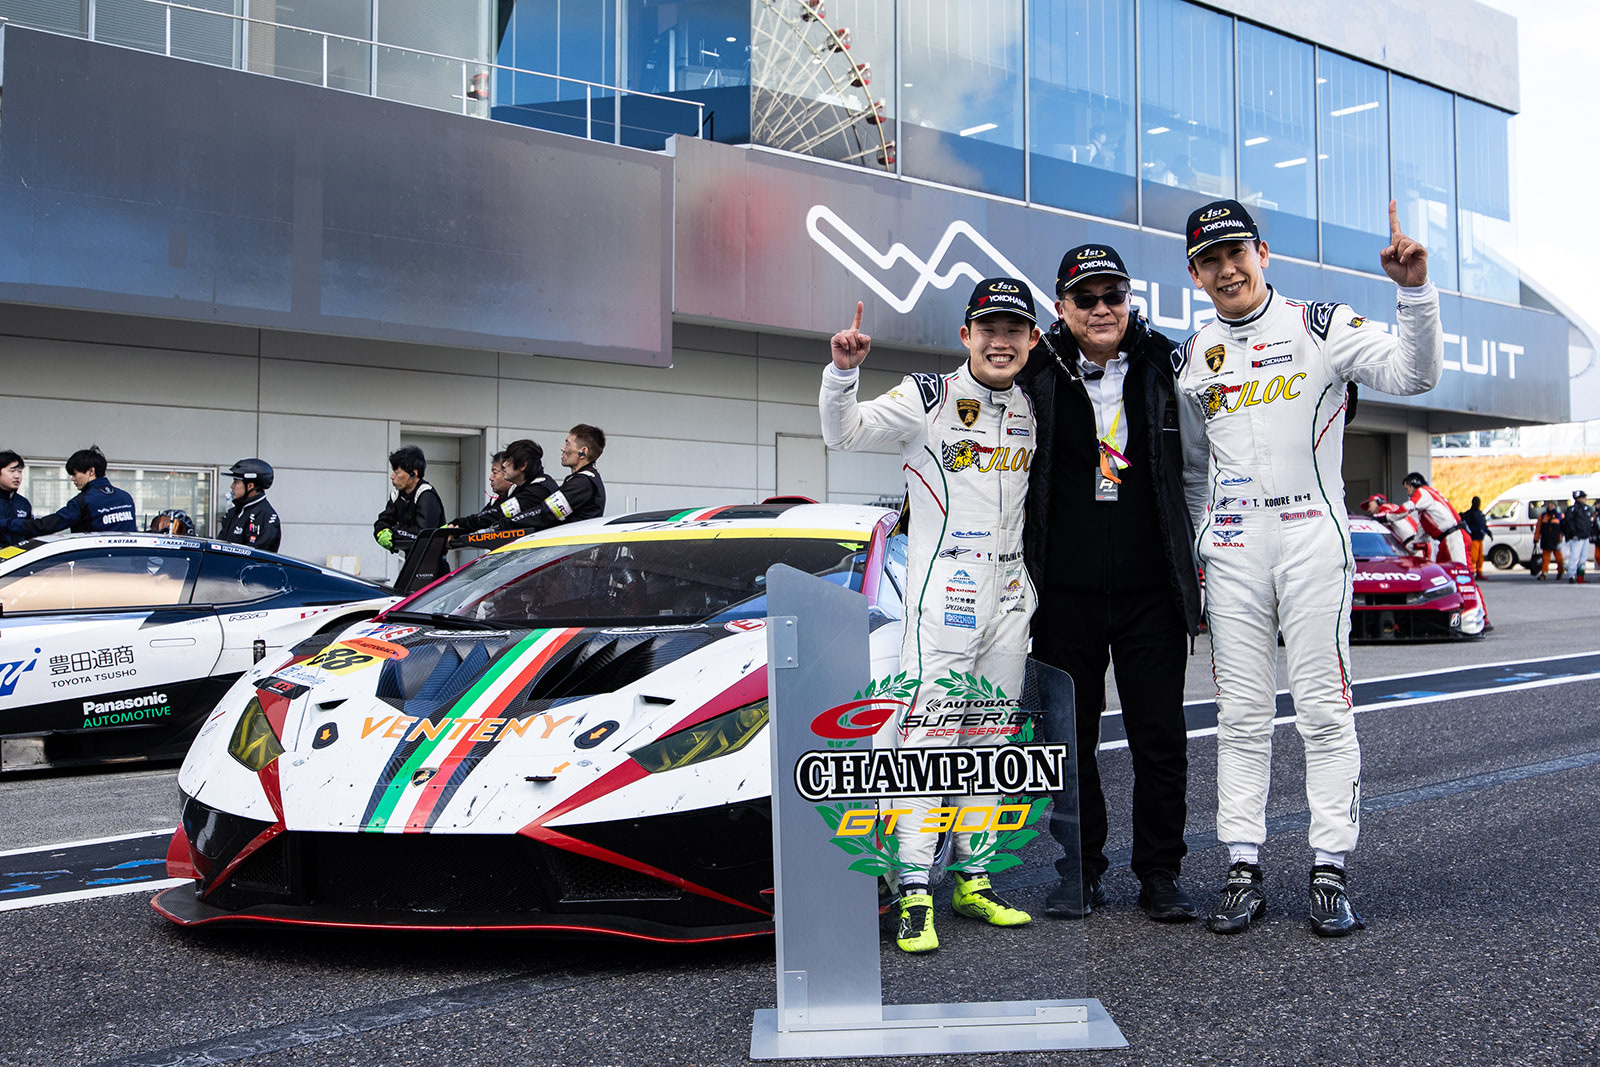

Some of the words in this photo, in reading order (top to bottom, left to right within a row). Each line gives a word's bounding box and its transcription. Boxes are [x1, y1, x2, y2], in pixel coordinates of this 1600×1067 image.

[1207, 208, 1222, 218] 1st
[1201, 220, 1245, 234] YOKOHAMA
[1084, 248, 1099, 257] 1st
[1078, 260, 1118, 271] YOKOHAMA
[997, 281, 1012, 290] 1st
[989, 295, 1028, 309] YOKOHAMA
[1261, 355, 1292, 367] YOKOHAMA
[1227, 372, 1307, 413] JLOC
[102, 511, 134, 525] OFFICIAL
[468, 529, 525, 543] KURIMOTO
[1353, 571, 1421, 581] stemo
[49, 645, 135, 676] 豊田通商
[306, 648, 374, 670] 88
[51, 676, 92, 688] TOYOTA
[95, 668, 138, 681] TSUSHO
[83, 691, 168, 715] Panasonic
[943, 699, 1023, 709] AUTOBACS
[83, 705, 172, 729] AUTOMOTIVE
[902, 712, 1000, 728] SUPER
[1007, 711, 1050, 725] GT
[360, 714, 575, 742] VENTENY
[925, 728, 965, 736] 2024
[967, 726, 1020, 736] SERIES
[795, 743, 1068, 801] CHAMPION
[836, 809, 913, 836] GT
[919, 804, 1031, 833] 300
